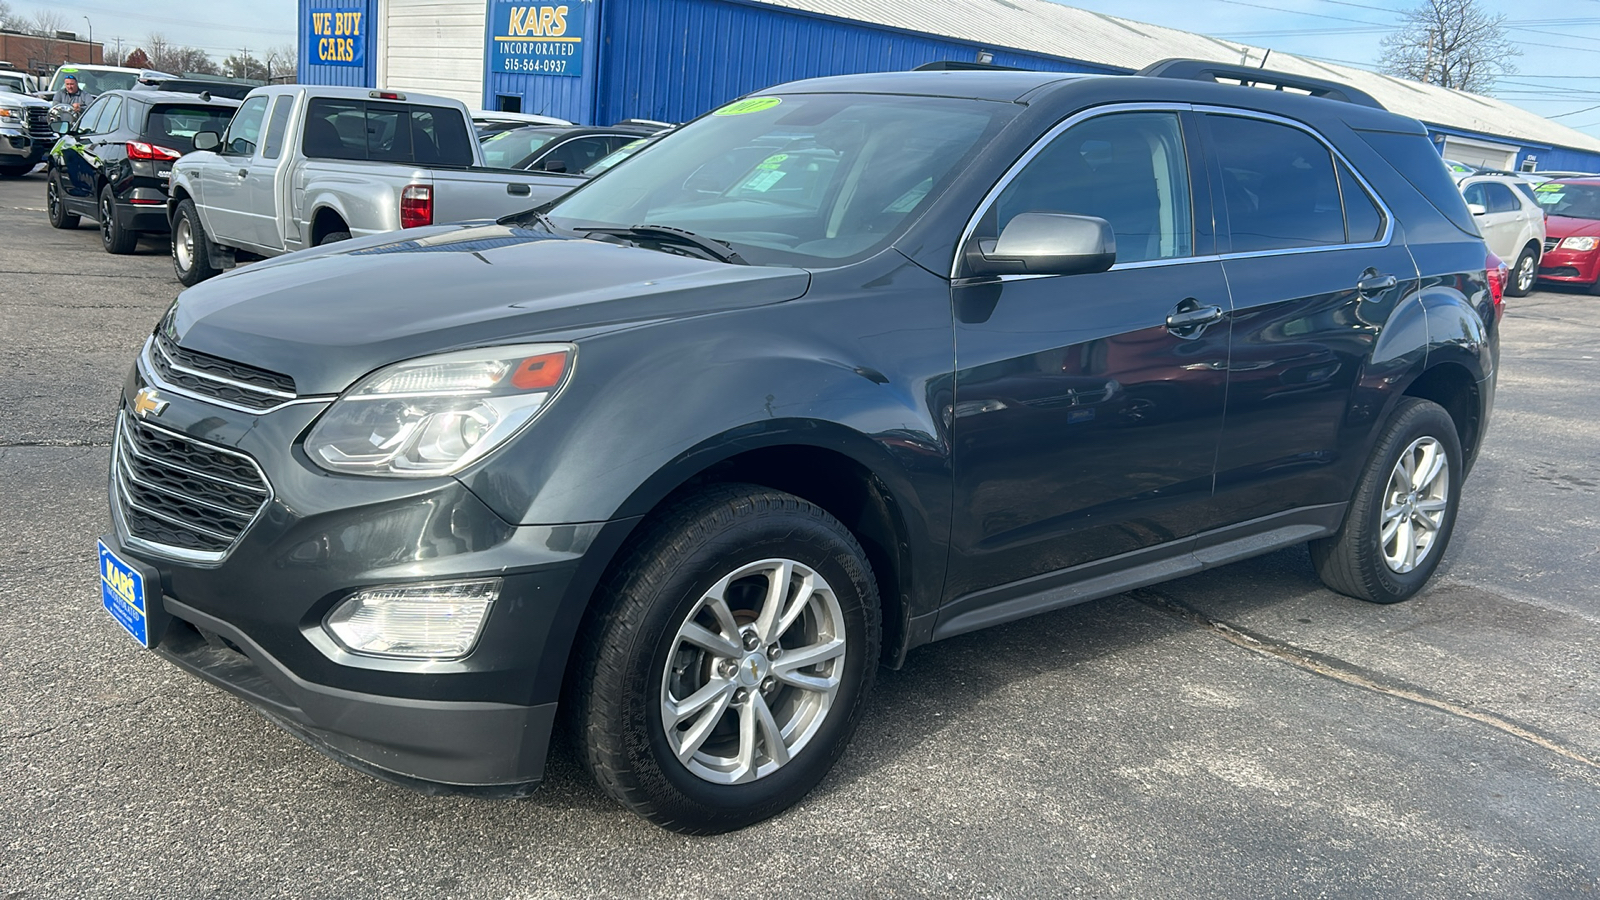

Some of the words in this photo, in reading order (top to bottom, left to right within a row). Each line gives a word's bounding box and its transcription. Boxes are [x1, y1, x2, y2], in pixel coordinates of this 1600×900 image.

[312, 12, 332, 35] WE
[334, 12, 362, 36] BUY
[508, 5, 568, 36] KARS
[318, 37, 354, 62] CARS
[499, 42, 574, 56] INCORPORATED
[504, 58, 566, 73] 515-564-0937
[105, 558, 135, 602] KARS
